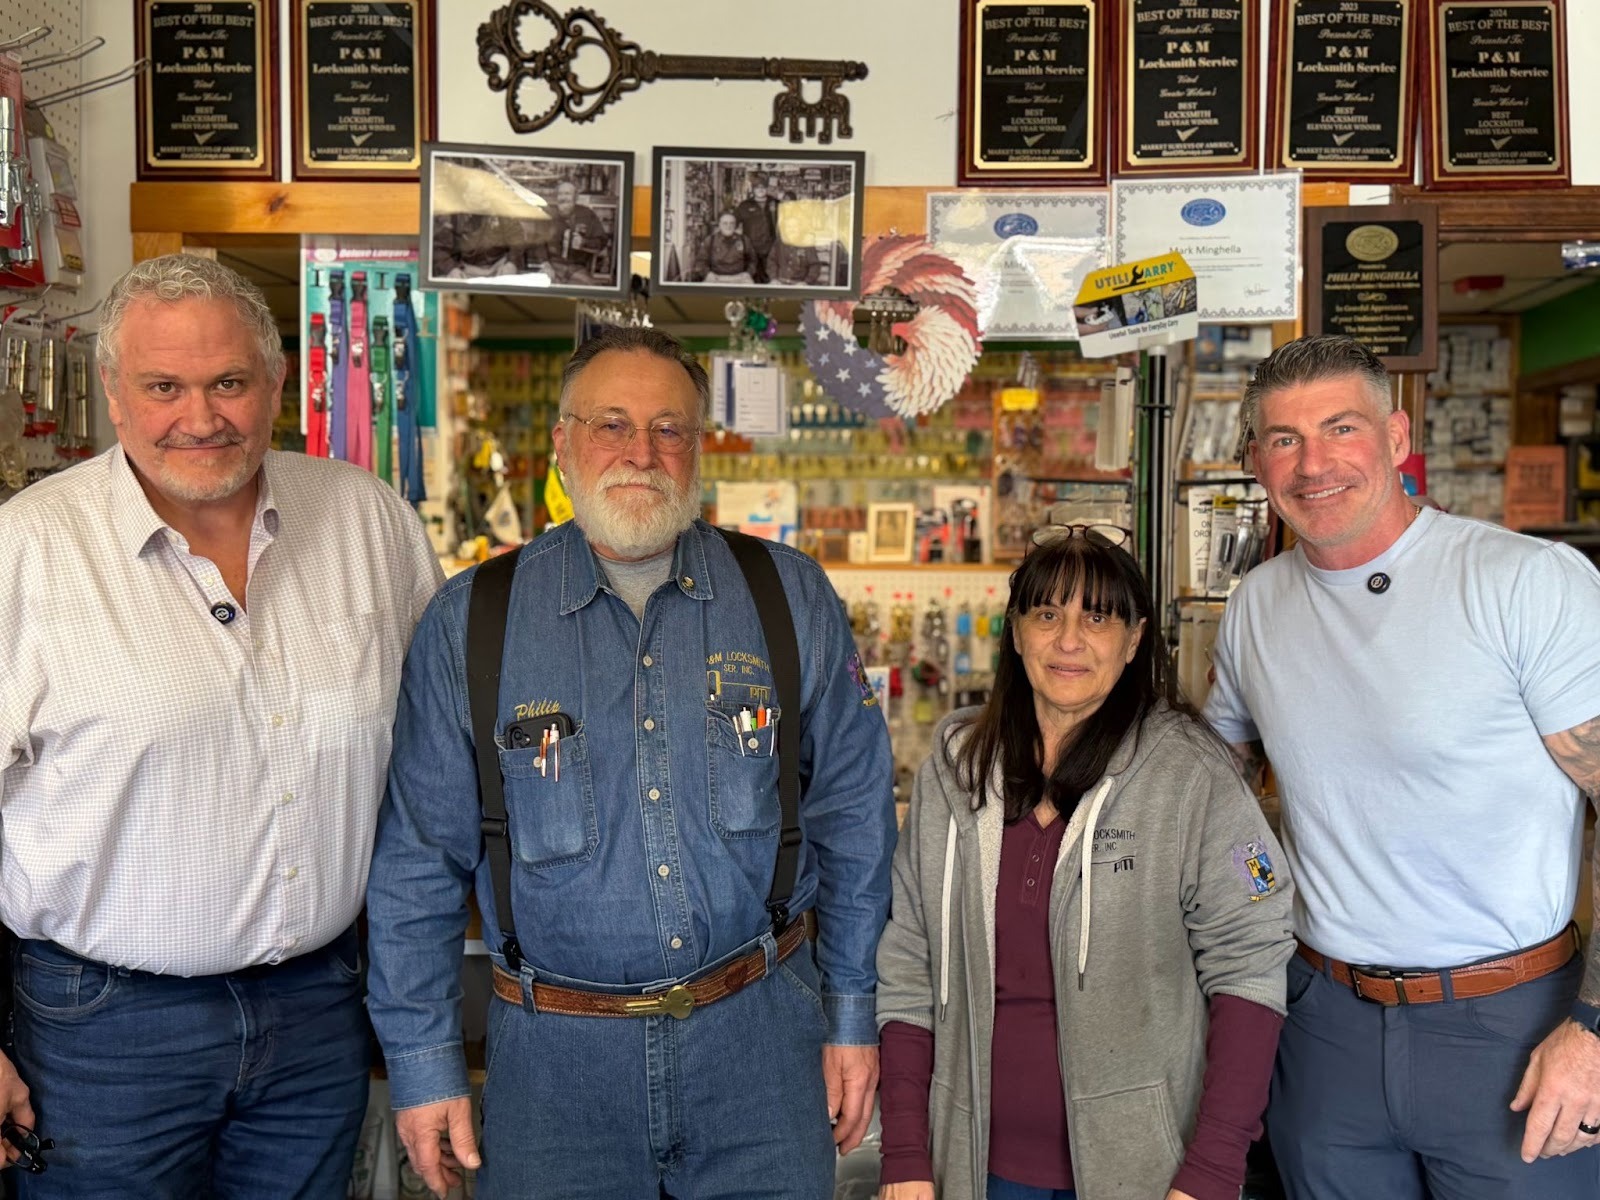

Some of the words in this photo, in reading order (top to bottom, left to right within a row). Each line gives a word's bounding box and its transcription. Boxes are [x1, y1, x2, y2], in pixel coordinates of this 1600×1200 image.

[1340, 2, 1359, 11] 2023
[1137, 10, 1165, 23] BEST
[1167, 9, 1183, 20] OF
[1185, 8, 1209, 19] THE
[1211, 8, 1240, 20] BEST
[1489, 9, 1508, 18] 2024
[153, 15, 181, 27] BEST
[182, 14, 197, 25] OF
[201, 14, 224, 25] THE
[225, 15, 254, 27] BEST
[309, 15, 337, 28] BEST
[340, 15, 356, 25] OF
[357, 15, 381, 25] THE
[382, 16, 411, 28] BEST
[984, 18, 1013, 30] BEST
[1014, 17, 1031, 28] OF
[1034, 17, 1056, 28] THE
[1059, 18, 1088, 30] BEST
[1296, 13, 1326, 26] BEST
[1327, 13, 1344, 24] OF
[1346, 13, 1370, 24] THE
[1372, 14, 1401, 27] BEST
[1448, 21, 1475, 32] BEST
[1477, 19, 1494, 30] OF
[1495, 19, 1519, 30] THE
[1521, 20, 1550, 31] BEST
[182, 46, 193, 59] P
[195, 47, 209, 59] &
[210, 46, 224, 59] M
[340, 47, 350, 59] P
[352, 47, 366, 59] &
[367, 47, 382, 59] M
[1166, 41, 1178, 54] P
[1179, 41, 1194, 54] &
[1195, 41, 1210, 53] M
[1325, 46, 1337, 58] P
[1338, 45, 1353, 58] &
[1354, 46, 1369, 58] M
[1014, 49, 1025, 61] P
[1027, 49, 1041, 61] &
[1042, 49, 1057, 61] M
[1478, 51, 1489, 63] P
[1490, 52, 1504, 63] &
[1506, 51, 1521, 63] M
[156, 62, 212, 73] Locksmith
[213, 61, 252, 73] Service
[1139, 58, 1197, 69] Locksmith
[1198, 56, 1239, 67] Service
[1297, 61, 1355, 73] Locksmith
[1356, 62, 1397, 73] Service
[312, 63, 369, 74] Locksmith
[370, 63, 409, 74] Service
[986, 65, 1043, 76] Locksmith
[1045, 65, 1085, 76] Service
[1451, 67, 1508, 78] Locksmith
[1509, 67, 1549, 78] Service
[195, 106, 215, 114] BEST
[352, 107, 371, 115] BEST
[1177, 102, 1198, 110] BEST
[1335, 106, 1355, 115] BEST
[1024, 108, 1044, 116] BEST
[1164, 110, 1211, 119] LOCKSMITH
[1491, 111, 1511, 119] BEST
[182, 114, 228, 123] LOCKSMITH
[339, 116, 384, 124] LOCKSMITH
[1011, 117, 1058, 125] LOCKSMITH
[1321, 115, 1368, 123] LOCKSMITH
[1478, 120, 1524, 128] LOCKSMITH
[1196, 245, 1242, 256] Minghella
[1327, 272, 1360, 282] PHILIP
[1361, 271, 1419, 281] MINGHELLA
[706, 652, 722, 665] &M
[726, 651, 771, 673] LOCKSMITH
[1093, 828, 1136, 840] OCKSMITH
